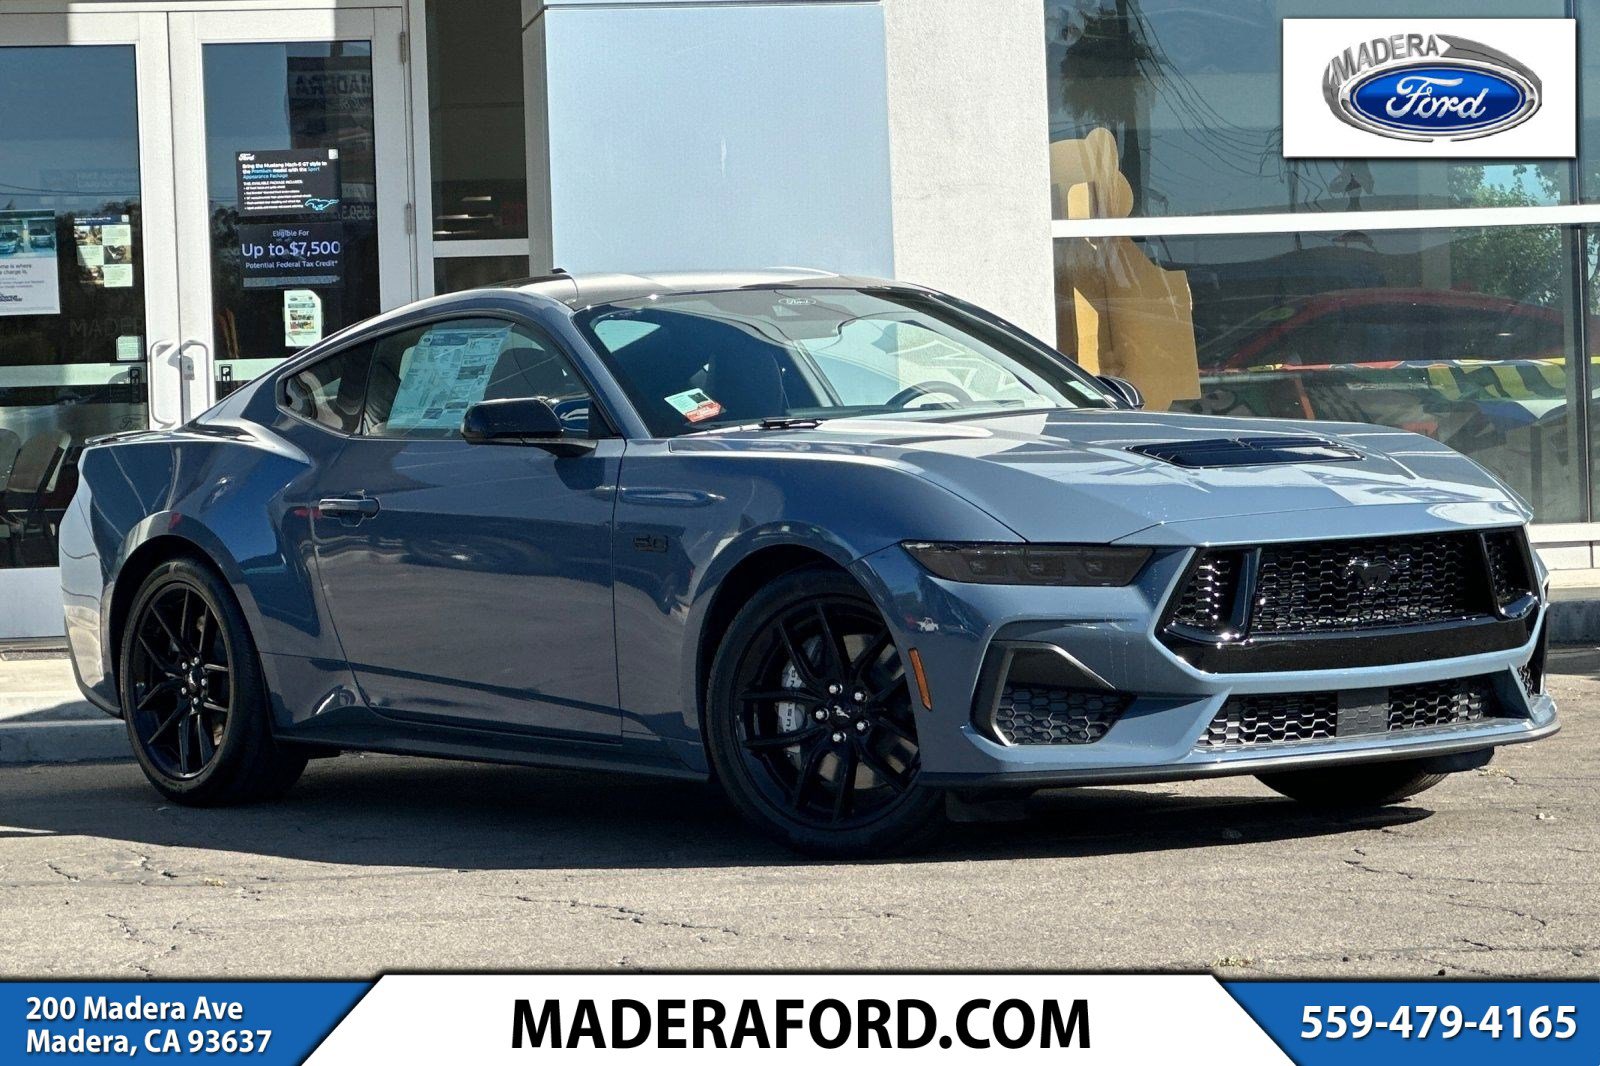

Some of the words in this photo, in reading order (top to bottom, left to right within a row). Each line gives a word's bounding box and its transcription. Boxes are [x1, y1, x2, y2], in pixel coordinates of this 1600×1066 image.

[272, 229, 297, 238] Eligible
[298, 229, 310, 237] For
[241, 243, 264, 259] Up
[268, 242, 285, 256] to
[289, 240, 341, 258] $7,500
[245, 261, 275, 269] Potential
[276, 260, 301, 268] Federal
[302, 260, 314, 268] Tax
